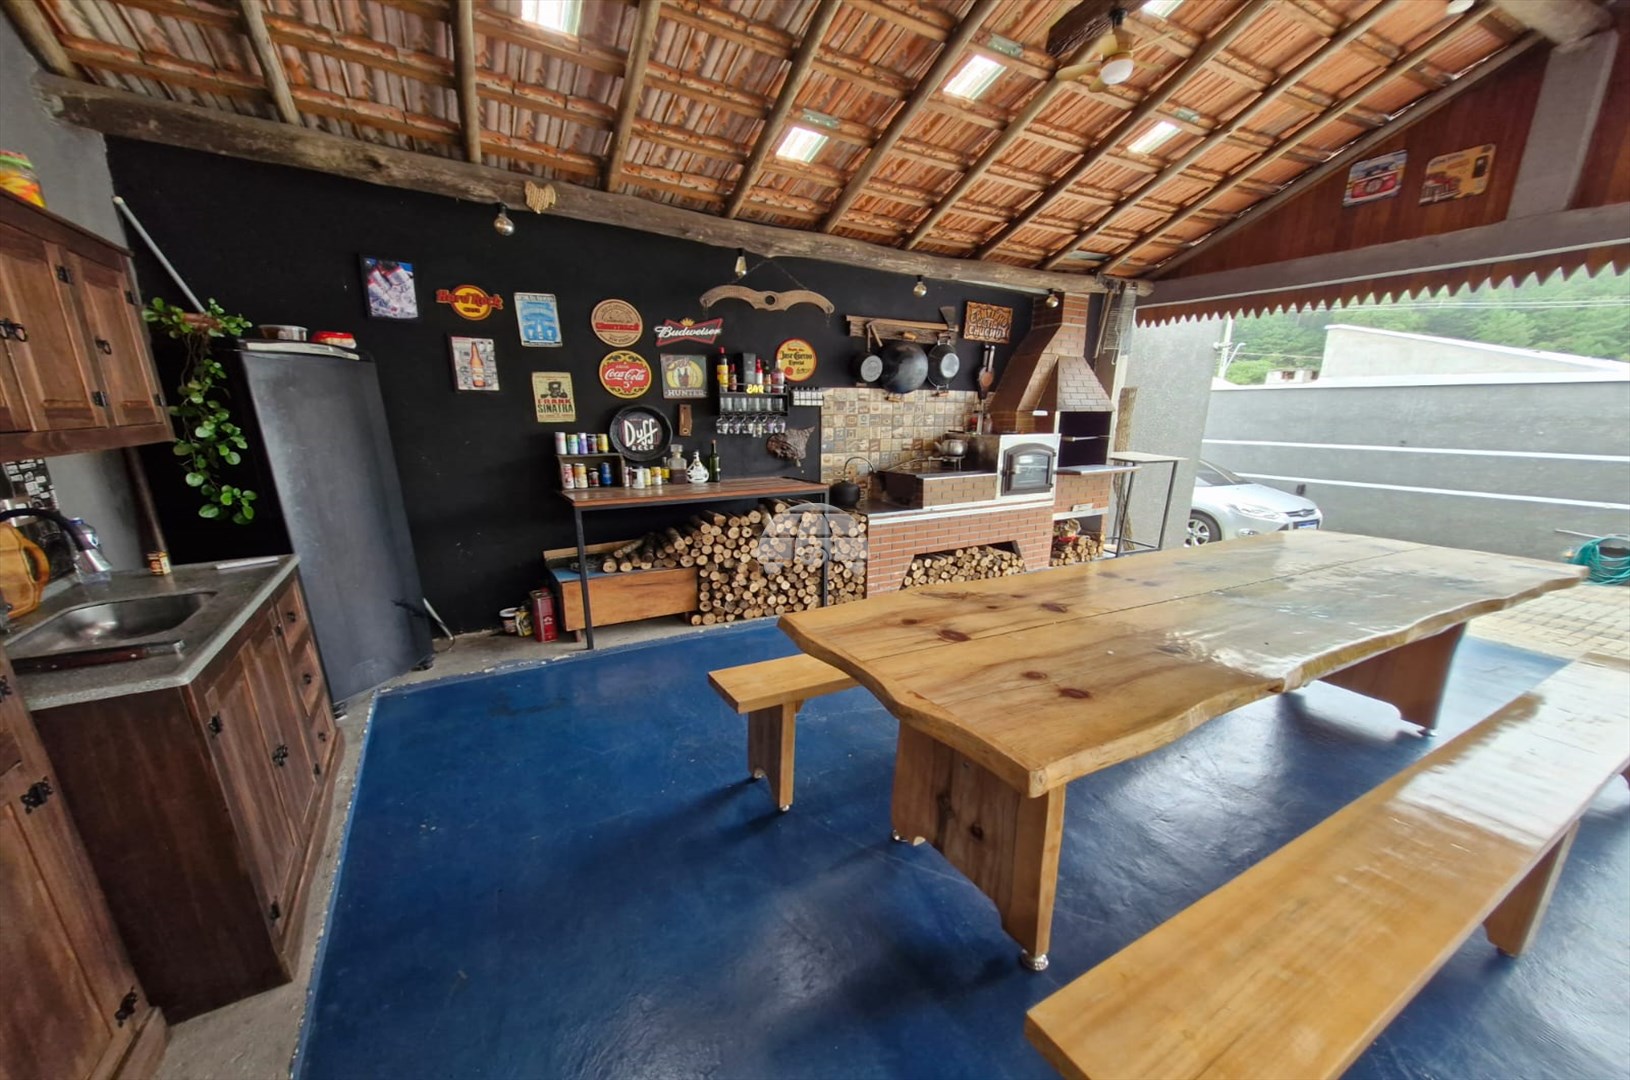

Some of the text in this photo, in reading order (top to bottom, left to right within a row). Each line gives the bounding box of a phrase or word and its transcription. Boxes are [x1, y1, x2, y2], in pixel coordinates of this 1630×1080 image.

[654, 325, 721, 338] Budweiser
[667, 389, 704, 397] HUNTER
[746, 383, 765, 394] BAR
[537, 404, 574, 413] SINATRA
[623, 418, 659, 448] Duff
